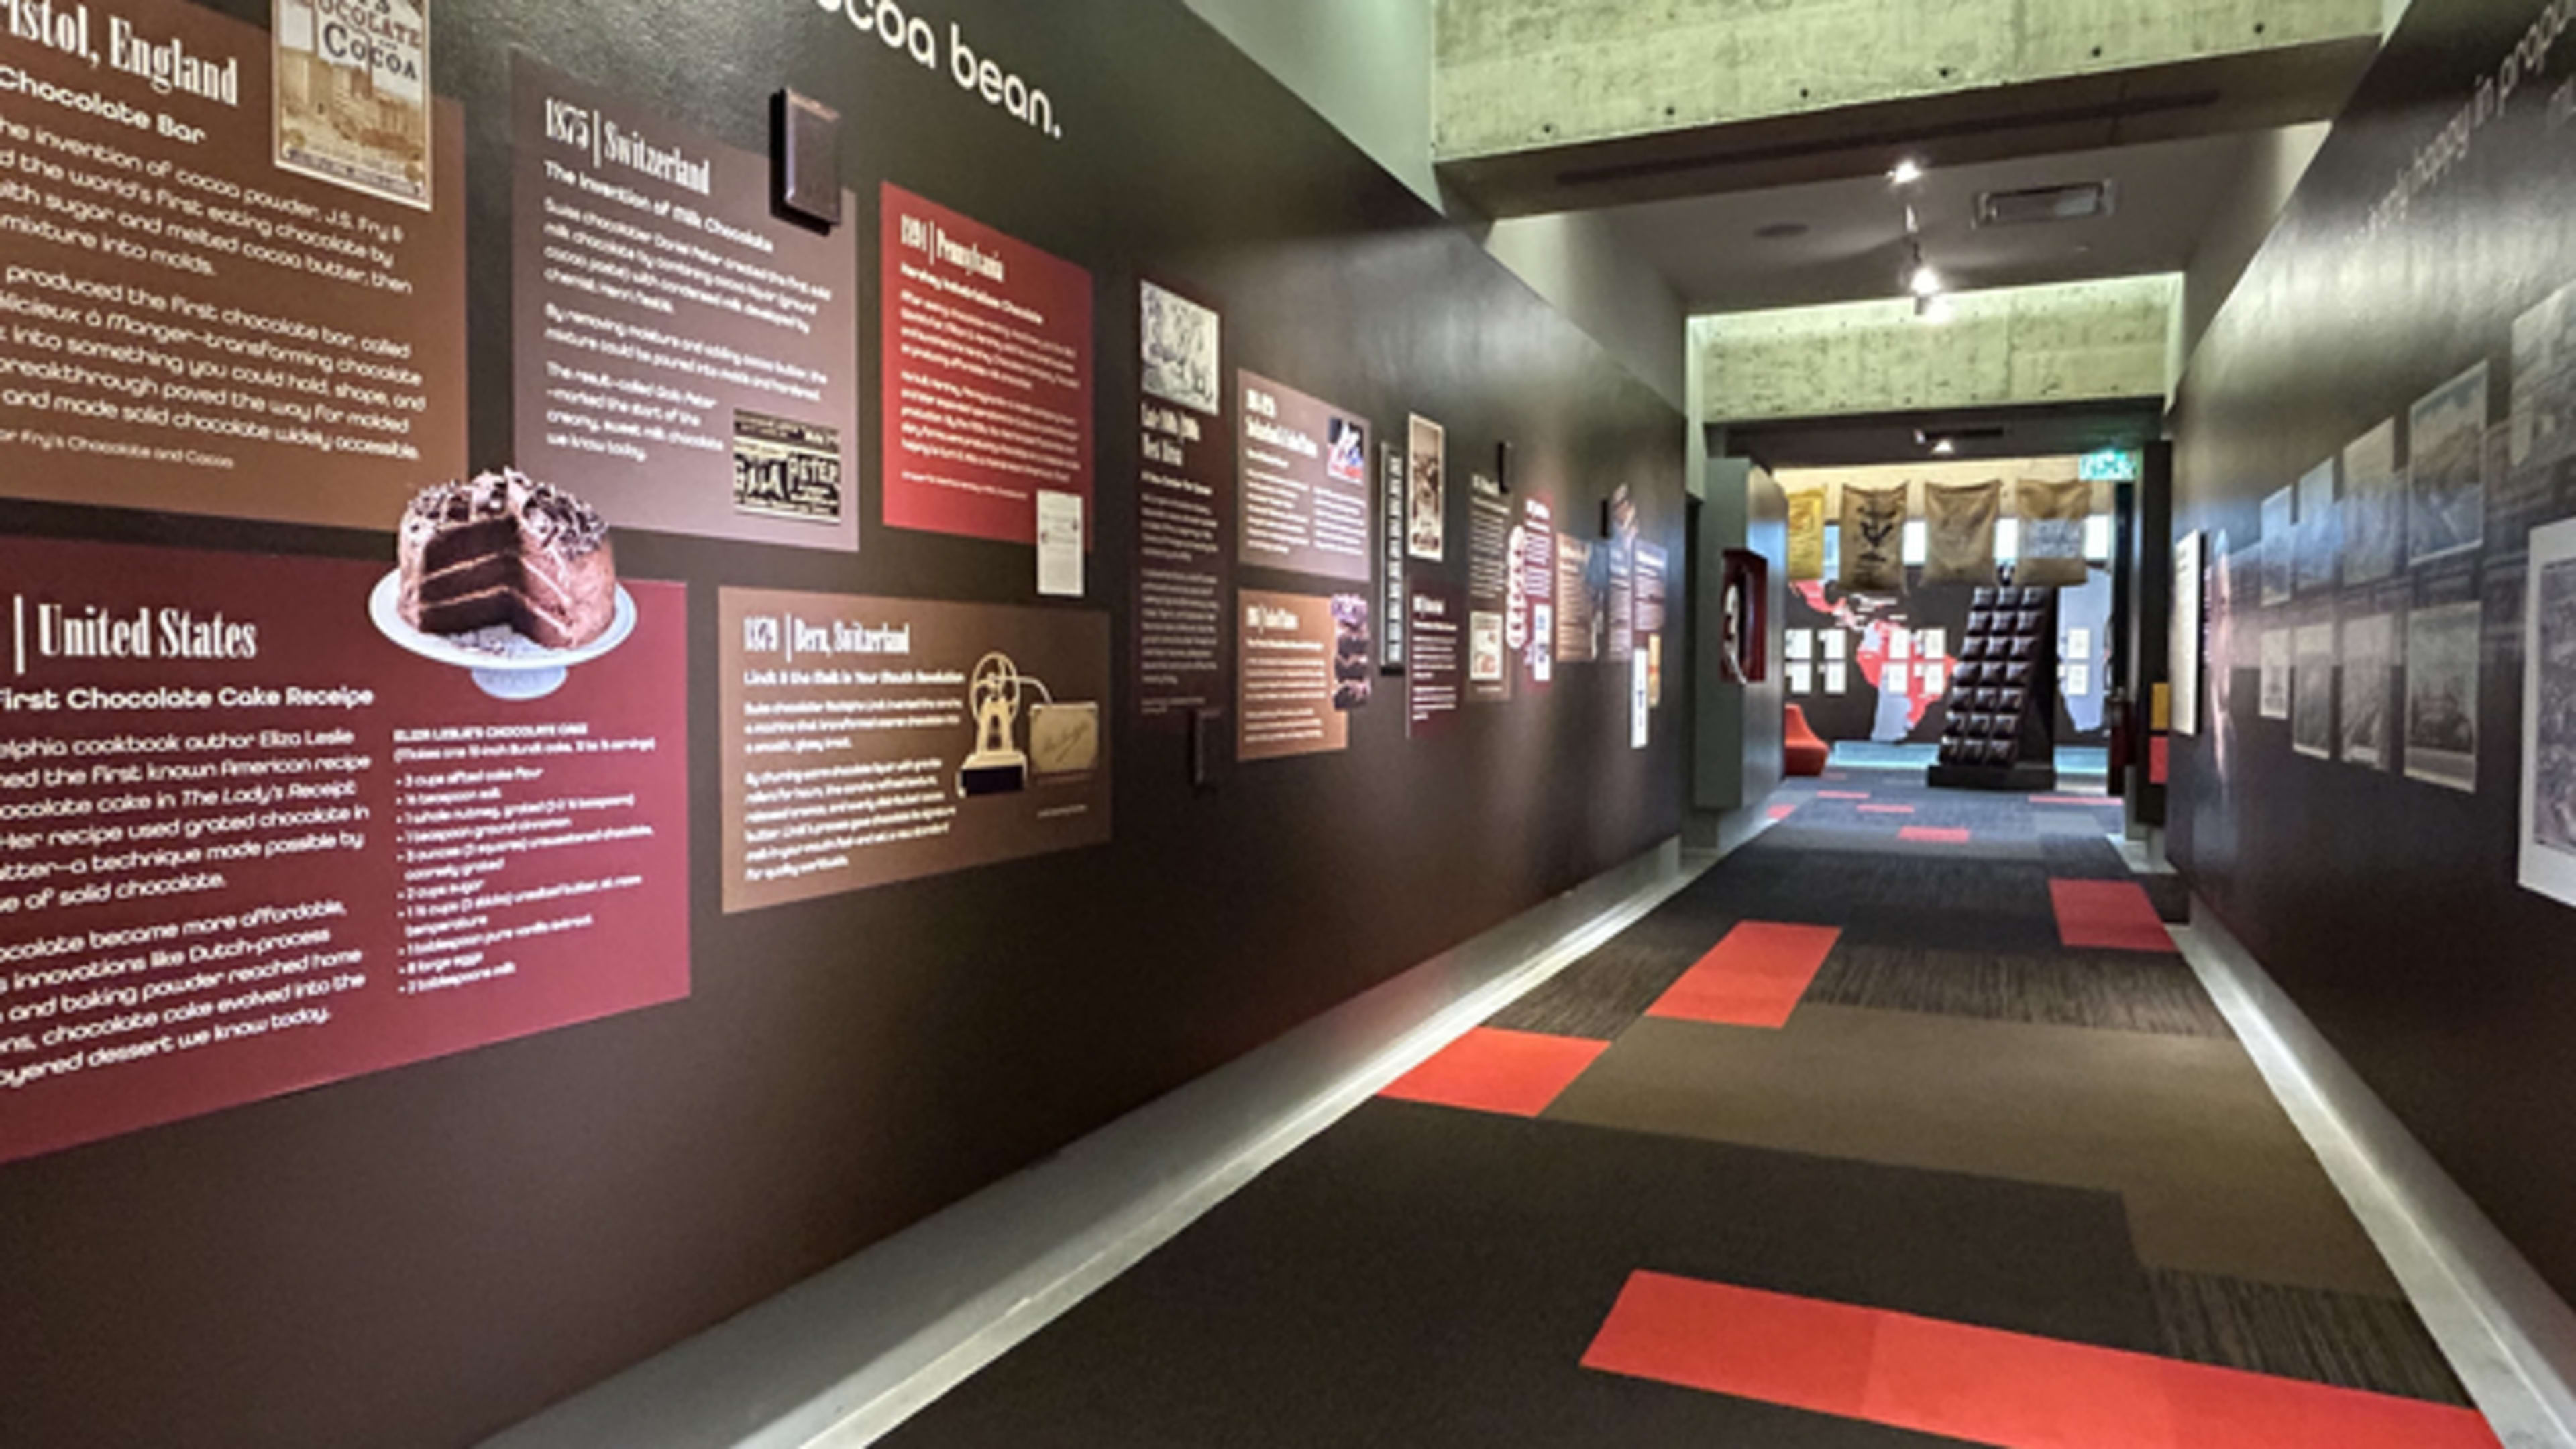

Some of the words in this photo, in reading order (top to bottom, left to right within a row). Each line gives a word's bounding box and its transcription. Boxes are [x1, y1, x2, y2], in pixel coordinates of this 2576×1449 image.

[0, 0, 101, 69] istol,
[109, 15, 239, 105] England
[817, 0, 936, 68] coa
[951, 22, 1062, 139] bean.
[0, 65, 152, 131] Chocolate
[157, 111, 207, 144] Bar
[35, 127, 142, 170] invention
[146, 161, 172, 177] of
[176, 169, 240, 198] cocoa
[546, 99, 588, 148] 1875
[605, 121, 710, 195] Switzerland
[20, 154, 64, 180] the
[156, 189, 203, 216] first
[208, 207, 272, 237] eating
[276, 224, 368, 258] chocolate
[370, 246, 393, 268] by
[0, 215, 97, 248] mixture
[102, 234, 147, 260] into
[46, 194, 114, 221] sugar
[117, 212, 162, 234] and
[166, 224, 239, 253] melted
[242, 243, 302, 268] cocoa
[372, 272, 412, 294] then
[6, 266, 122, 301] produced
[127, 288, 167, 311] the
[172, 295, 218, 321] first
[222, 309, 319, 340] chocolate
[13, 325, 62, 350] into
[67, 339, 184, 374] something
[189, 361, 227, 378] you
[231, 367, 284, 387] could
[393, 394, 426, 412] and
[337, 358, 422, 386] chocolate
[1, 390, 50, 409] and
[54, 396, 118, 419] made
[122, 407, 169, 425] solid
[172, 412, 272, 439] chocolate
[275, 429, 333, 451] widely
[162, 383, 227, 405] paved
[231, 392, 266, 411] the
[269, 402, 311, 423] way
[315, 403, 344, 423] for
[347, 413, 409, 433] molded
[39, 604, 150, 657] United
[159, 607, 258, 659] States
[67, 686, 213, 710] Chocolate
[218, 686, 281, 707] Cake
[286, 684, 374, 710] Receipe
[72, 734, 180, 755] cookbook
[185, 733, 255, 751] author
[259, 730, 301, 747] Eliza
[44, 768, 87, 787] the
[92, 765, 142, 783] first
[147, 763, 217, 780] known
[221, 759, 312, 775] American
[315, 756, 372, 771] recipe
[97, 794, 152, 812] cake
[157, 792, 176, 808] in
[182, 790, 219, 806] The
[287, 780, 356, 798] Receipt
[48, 826, 123, 845] recipe
[128, 819, 180, 839] used
[184, 813, 255, 838] grated
[258, 807, 351, 827] chocolate
[354, 805, 370, 820] in
[92, 848, 201, 872] technique
[207, 841, 262, 859] made
[265, 833, 337, 857] possible
[339, 831, 364, 849] by
[25, 888, 54, 909] of
[60, 883, 111, 906] solid
[89, 924, 178, 949] became
[182, 916, 237, 934] more
[8, 997, 57, 1021] and
[61, 987, 138, 1012] baking
[142, 973, 225, 1002] powder
[228, 955, 309, 983] reached
[312, 949, 362, 967] home
[14, 958, 146, 989] innovations
[151, 951, 185, 967] like
[42, 1012, 158, 1045] chocolate
[163, 1002, 214, 1023] cake
[217, 984, 291, 1012] evolved
[294, 980, 333, 998] into
[333, 974, 366, 991] the
[87, 1036, 174, 1066] dessert
[178, 1030, 211, 1048] we
[215, 1020, 268, 1040] know
